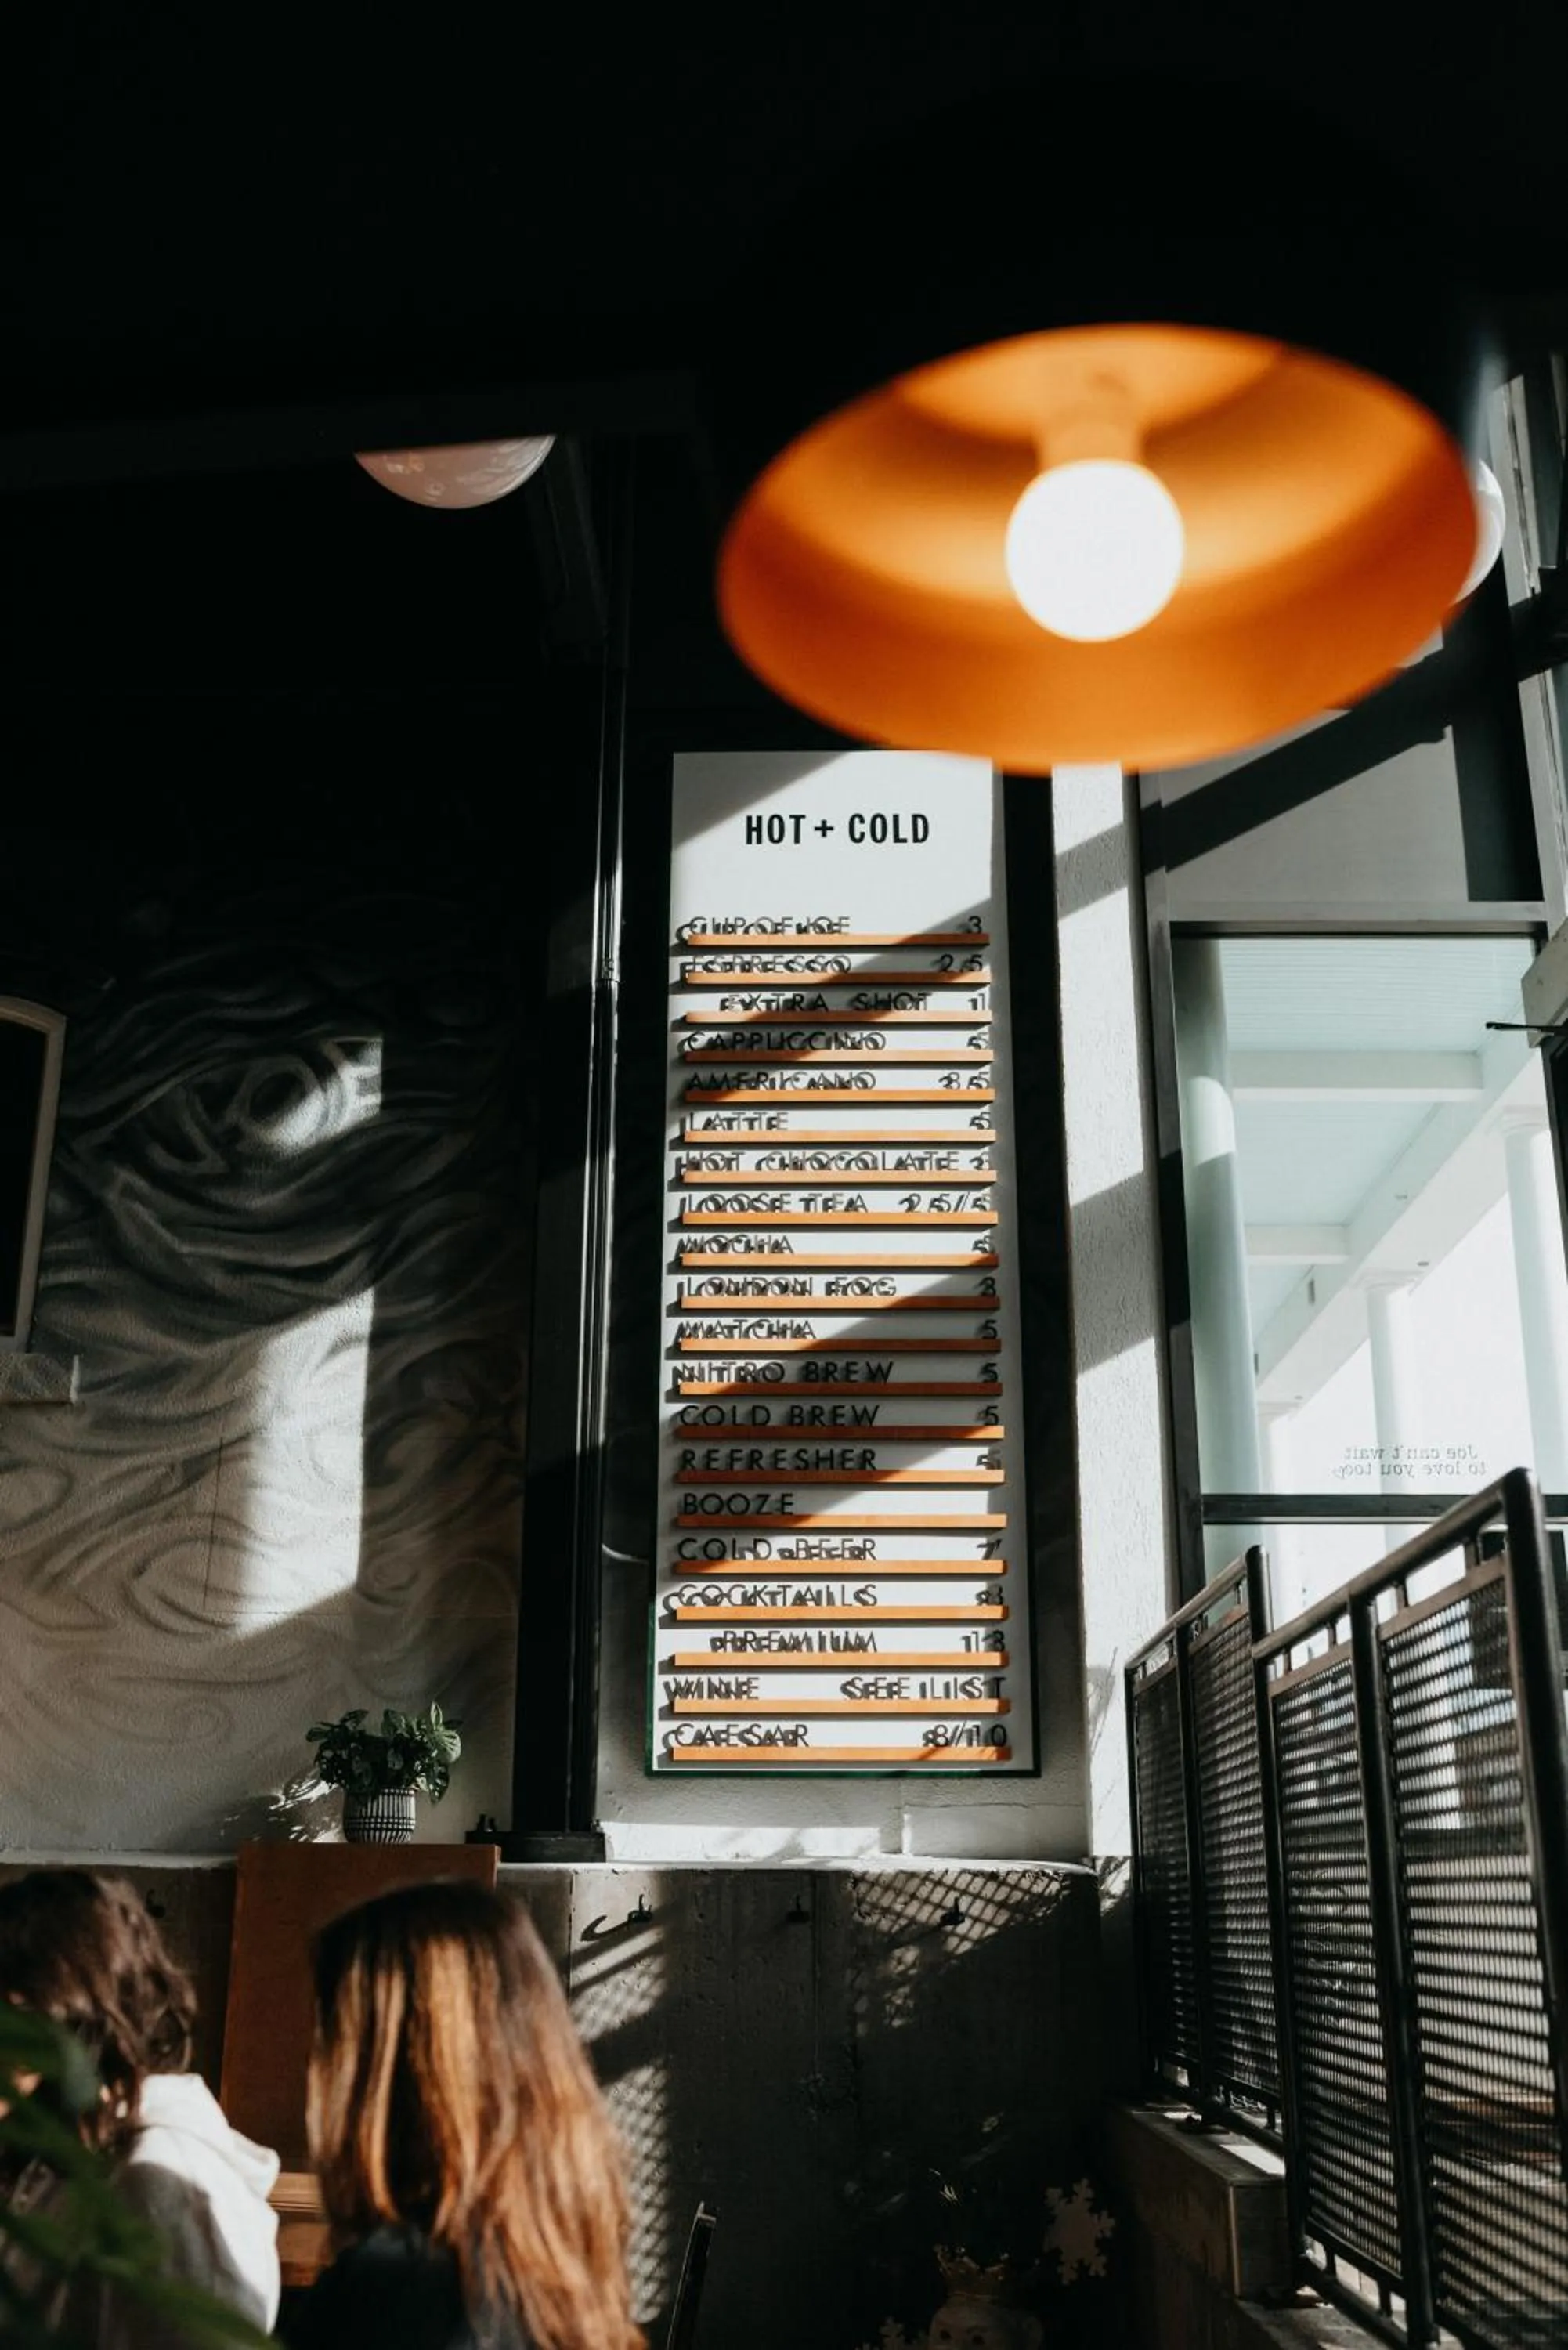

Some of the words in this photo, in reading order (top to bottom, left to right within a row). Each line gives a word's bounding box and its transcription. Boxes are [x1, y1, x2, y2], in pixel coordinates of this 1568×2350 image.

[746, 814, 806, 844] HOT
[814, 819, 834, 838] +
[848, 813, 930, 844] COLD
[688, 916, 746, 935] CUP
[754, 916, 793, 935] OF
[968, 916, 982, 935] 3
[692, 954, 851, 973] ESPRESSO
[730, 992, 829, 1012] EXTRA
[858, 992, 932, 1012] SHOT
[687, 1031, 887, 1050] CAPPUCCINO
[689, 1071, 876, 1090] AMERICANO
[690, 1112, 789, 1131] LATTE
[686, 1151, 745, 1171] HOT
[765, 1151, 959, 1171] CHOCOLATE
[687, 1193, 792, 1213] LOOSE
[809, 1193, 869, 1213] TEA
[686, 1235, 794, 1254] MOCHA
[687, 1276, 813, 1296] LONDON
[835, 1276, 897, 1296] FOG
[684, 1319, 818, 1340] MATCHA
[984, 1319, 999, 1340] 5
[682, 1361, 786, 1383] NITRO
[805, 1361, 894, 1383] BREW
[984, 1361, 999, 1383] 5
[680, 1405, 771, 1426] COLD
[788, 1405, 881, 1426] BREW
[984, 1405, 1000, 1426] 5
[681, 1448, 877, 1470] REFRESHER
[683, 1492, 794, 1515] BOOZE
[677, 1538, 772, 1560] COLD
[795, 1538, 877, 1560] BEER
[678, 1584, 878, 1607] COCKTAILS
[723, 1630, 878, 1653] PREMIUM
[671, 1676, 761, 1700] WINE
[851, 1676, 911, 1700] SEE
[930, 1676, 1007, 1700] LIST
[675, 1723, 810, 1747] CAESAR
[934, 1721, 1008, 1748] 8/10
